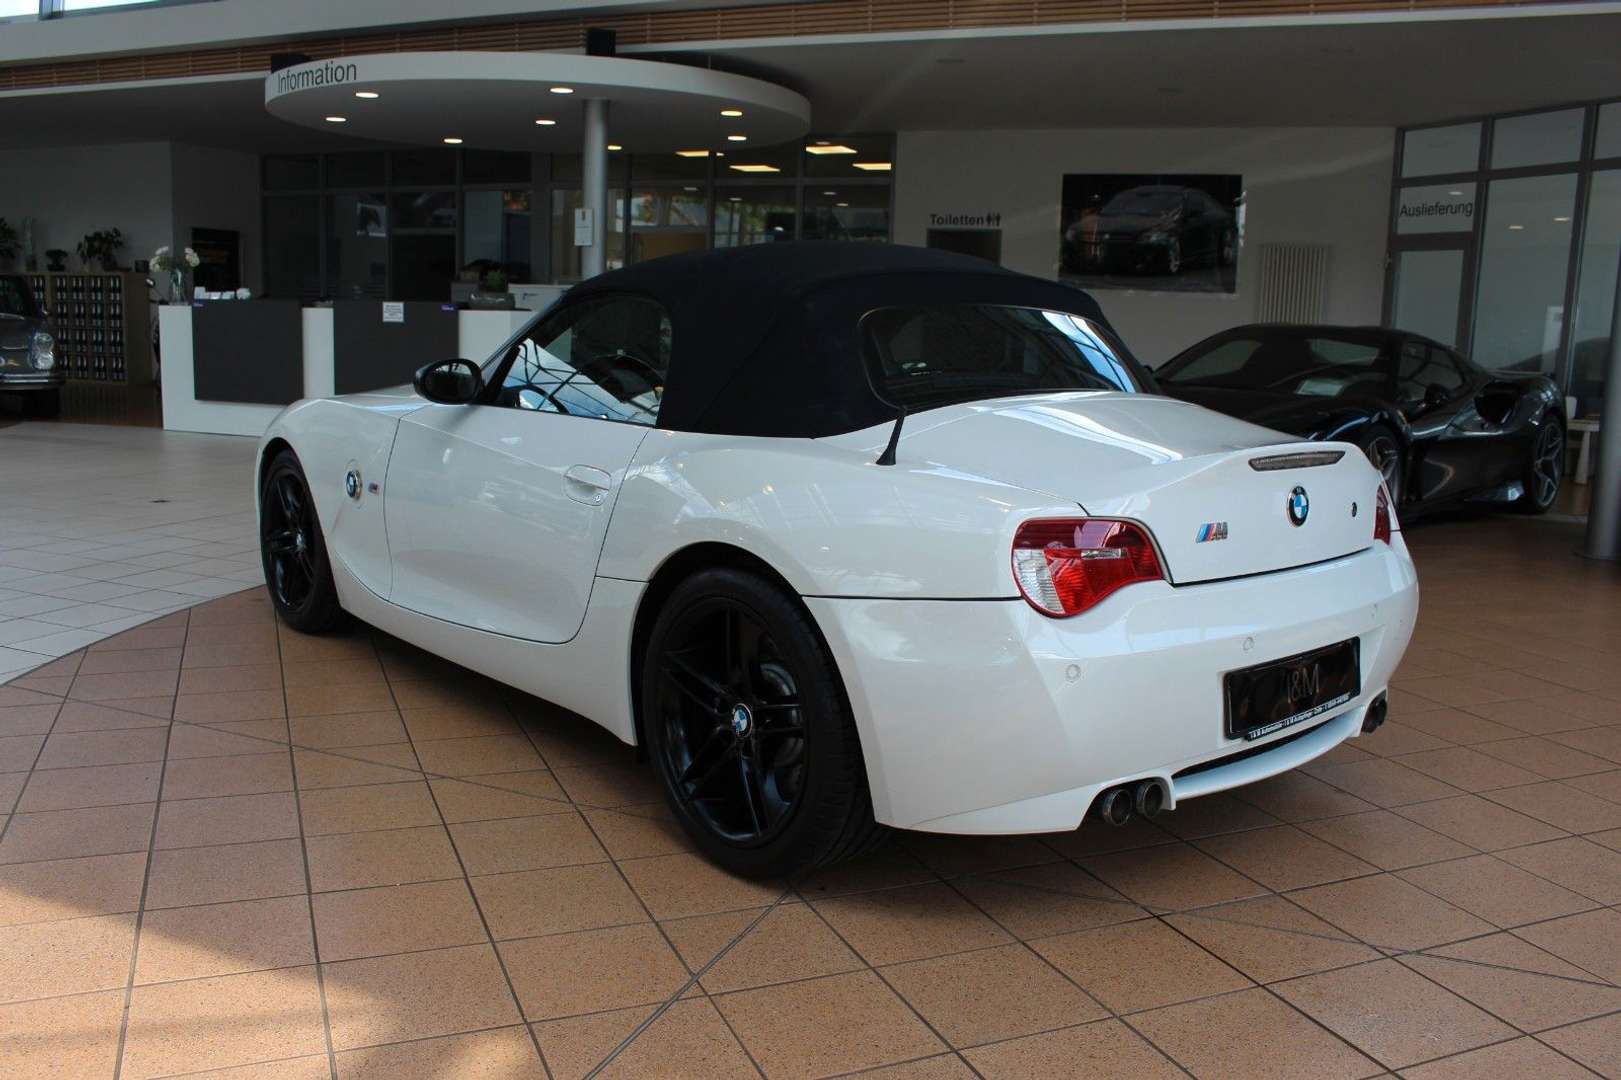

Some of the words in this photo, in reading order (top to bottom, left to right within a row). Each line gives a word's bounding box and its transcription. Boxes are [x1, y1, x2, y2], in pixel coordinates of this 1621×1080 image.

[278, 60, 357, 94] Information
[1399, 201, 1474, 218] Auslieferung
[930, 213, 985, 226] Toiletten
